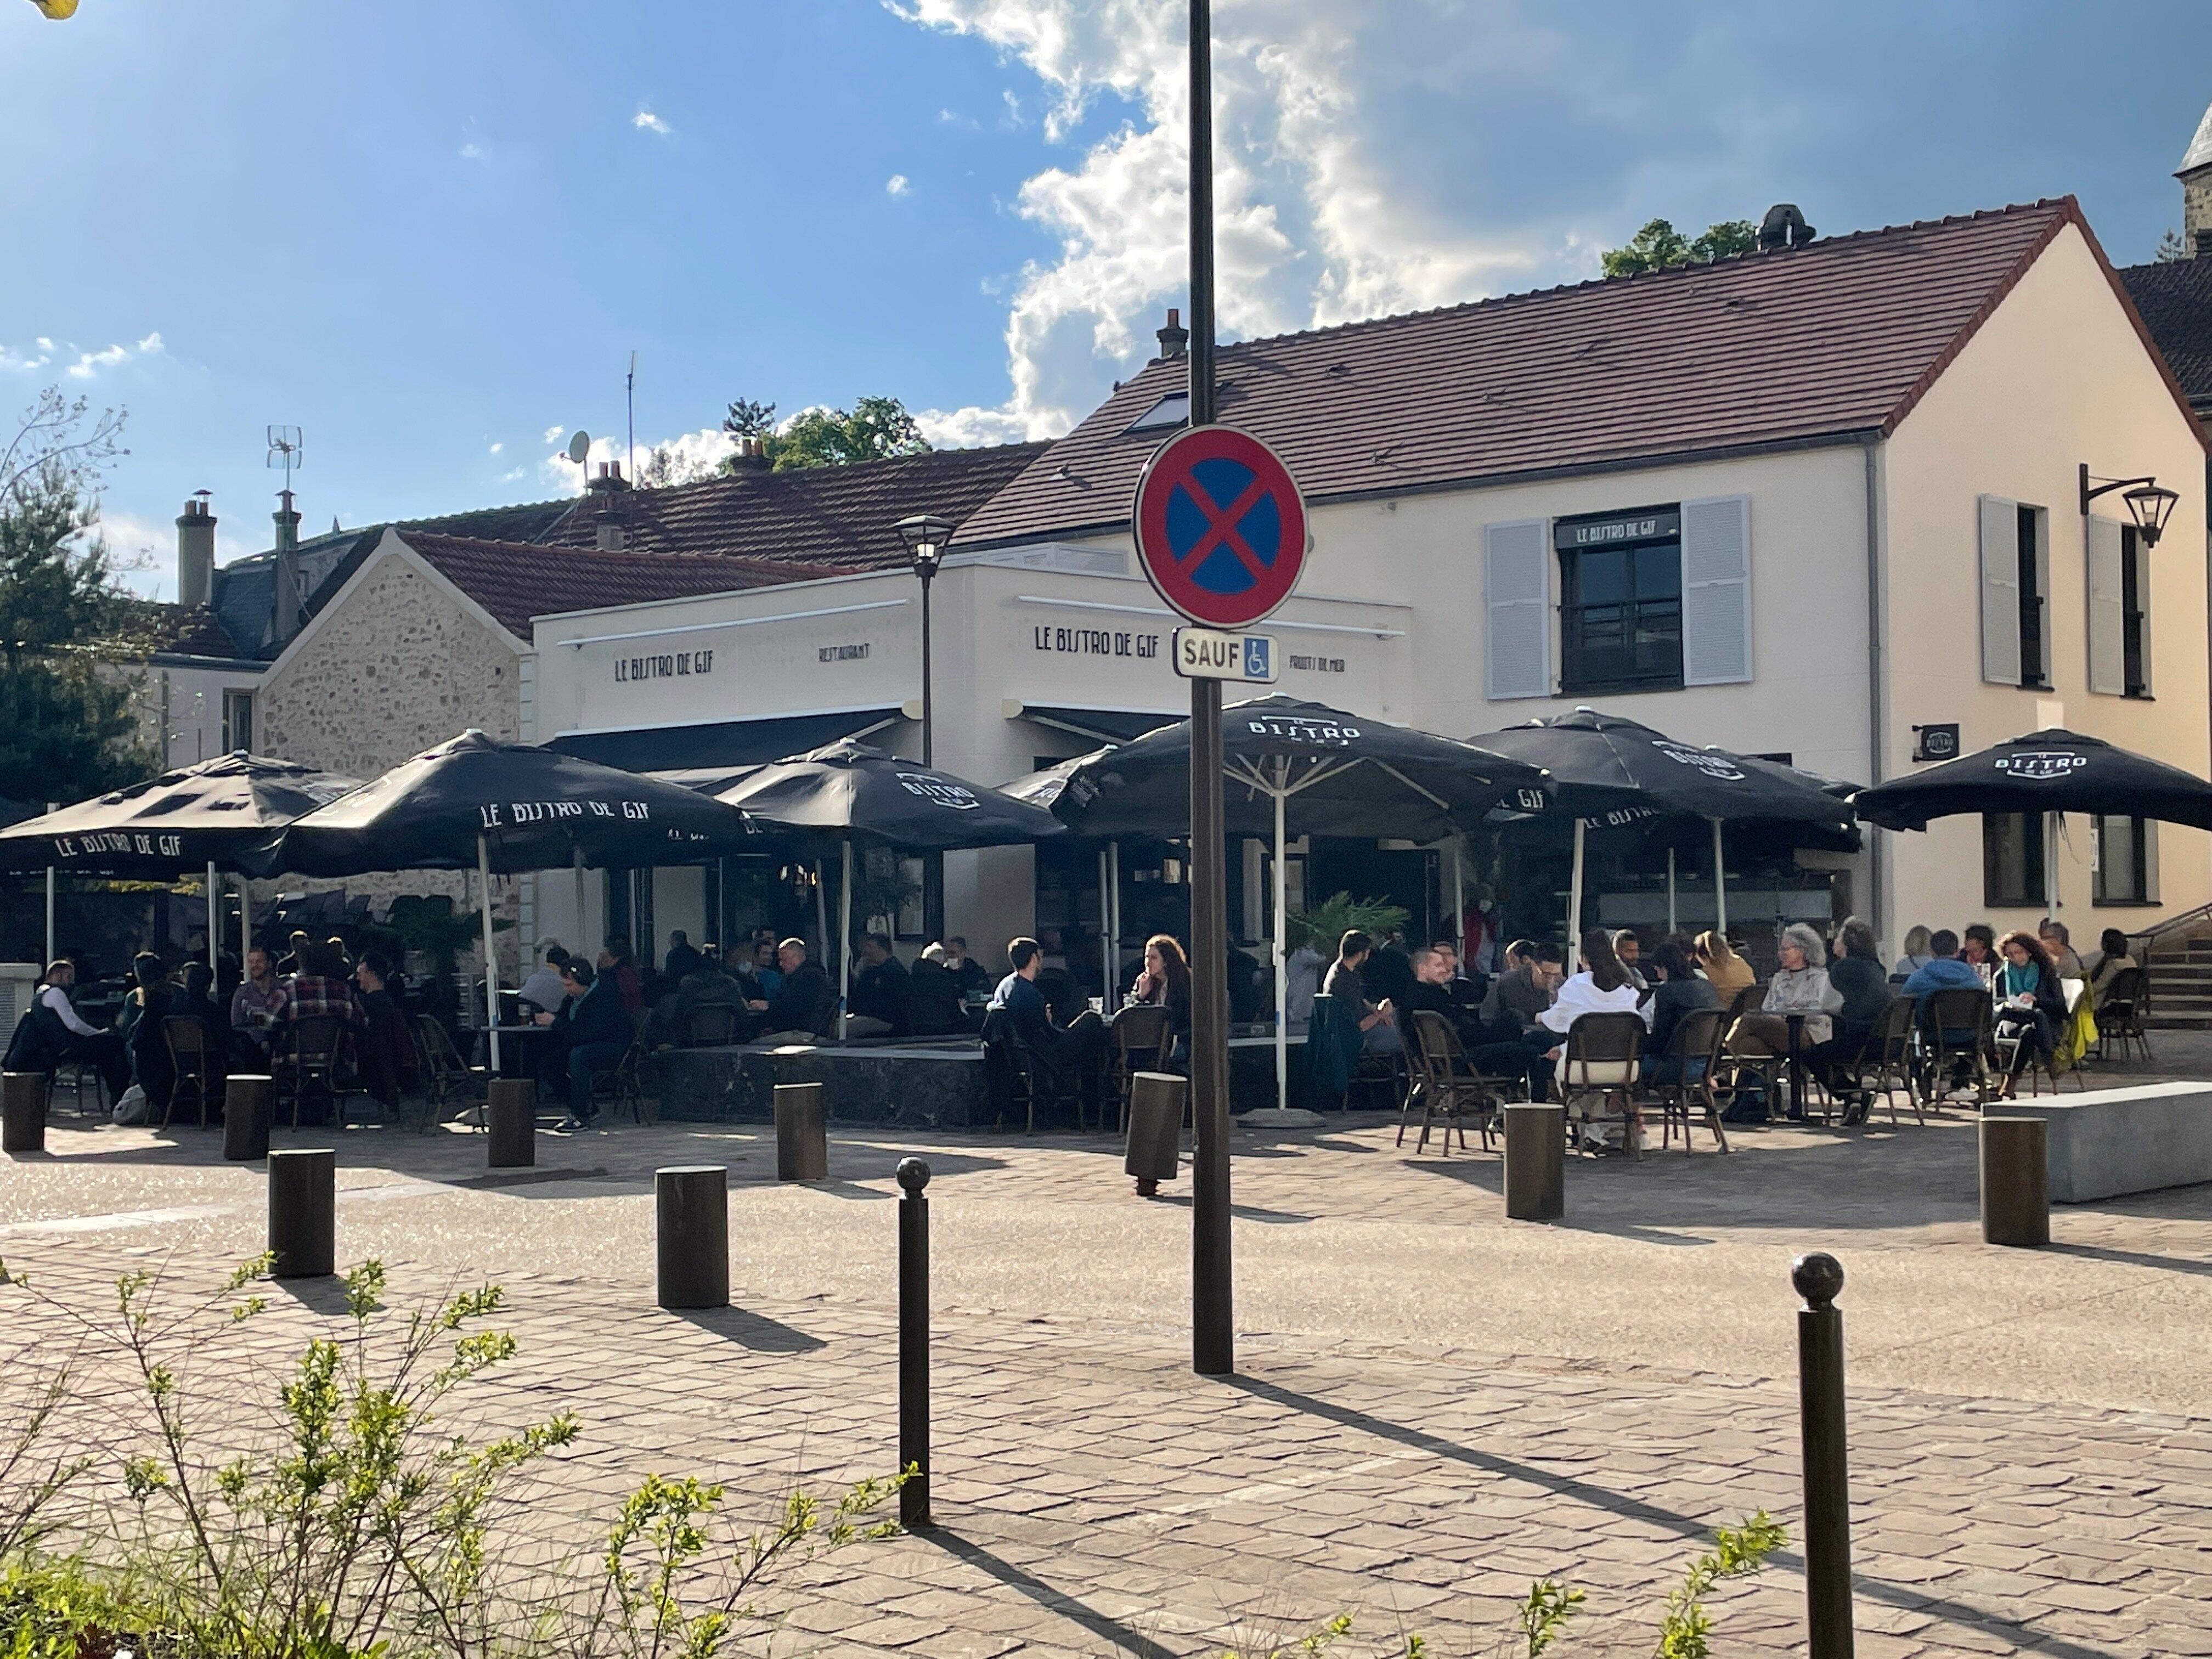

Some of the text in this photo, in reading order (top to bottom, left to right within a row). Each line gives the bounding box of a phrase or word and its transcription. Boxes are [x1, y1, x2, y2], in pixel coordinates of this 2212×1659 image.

[1577, 520, 1656, 543] LE BISTRO DE GIF
[819, 643, 870, 662] RESTAURANT
[1035, 627, 1159, 658] LE BISTRO DE GIF
[1184, 639, 1239, 668] SAUF
[615, 650, 713, 682] LE BISTRO DE GIF
[1248, 721, 1361, 738] BISTRO
[1995, 757, 2087, 769] BISTRO
[1517, 788, 1544, 809] GIF
[481, 800, 649, 828] LE BISTRO DE GIF
[55, 833, 180, 857] LE BISTRO DE GIF
